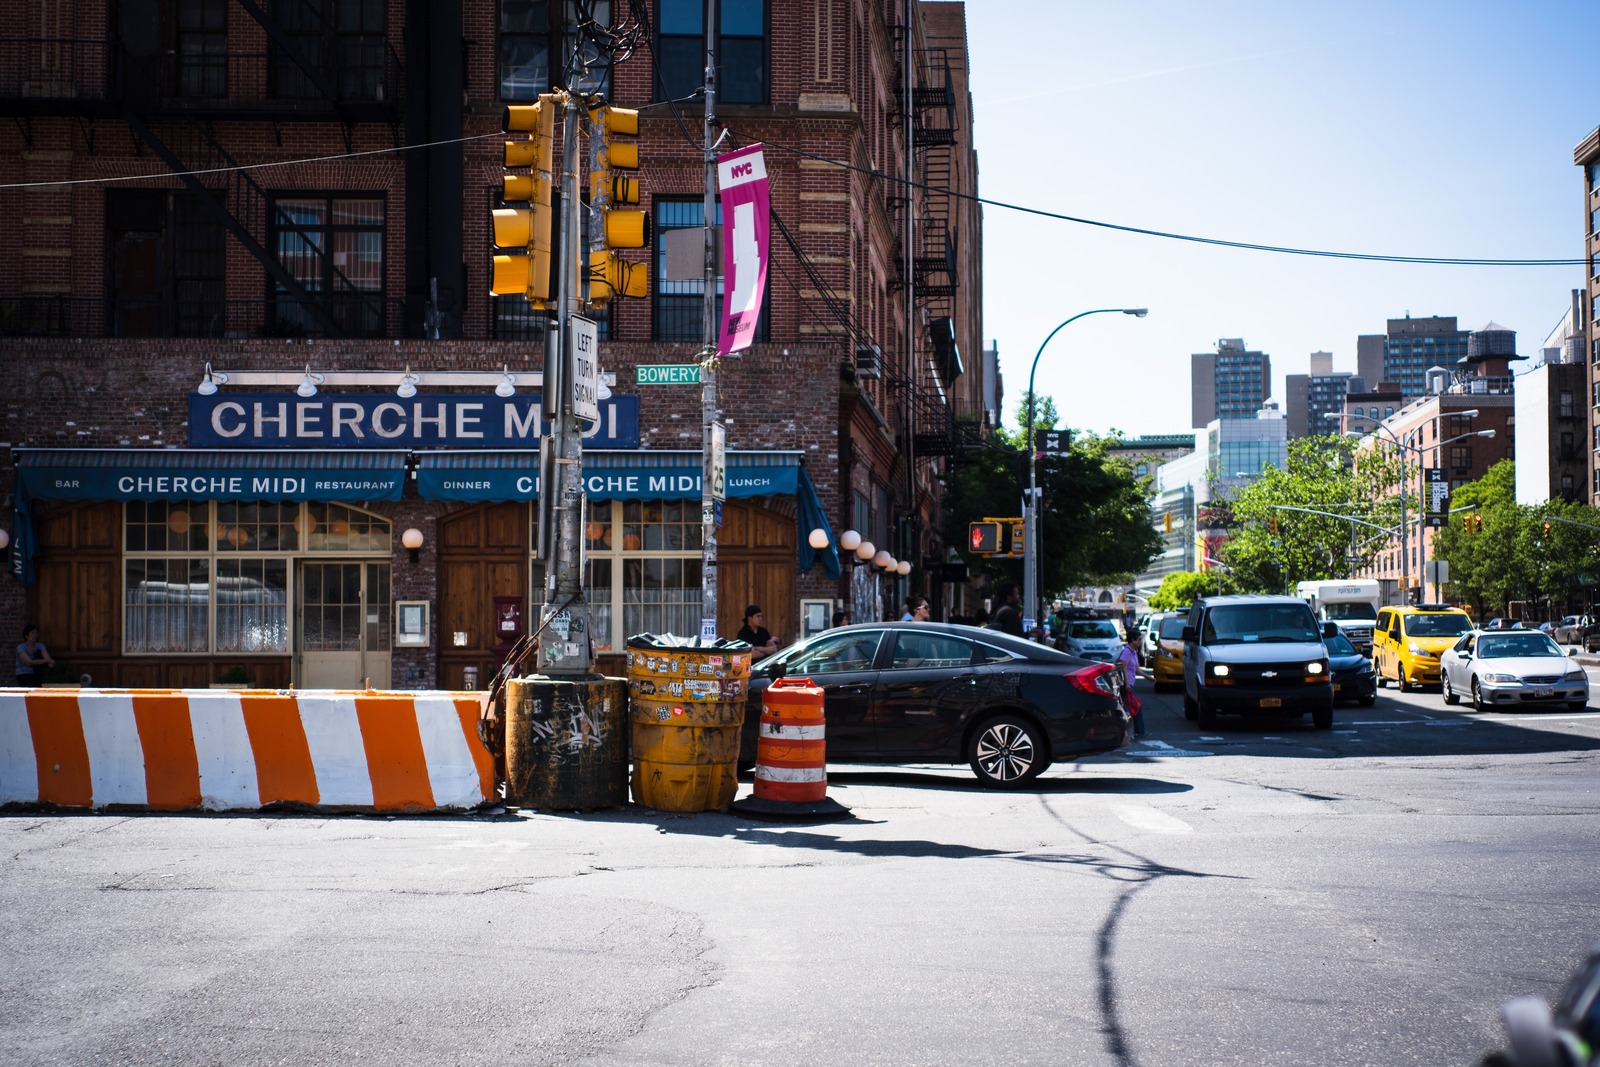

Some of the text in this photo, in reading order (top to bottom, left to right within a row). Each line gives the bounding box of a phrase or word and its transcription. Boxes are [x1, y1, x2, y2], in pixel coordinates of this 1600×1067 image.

[731, 162, 752, 179] NYC
[727, 321, 751, 336] MUSEUM
[728, 316, 742, 326] NEW
[577, 332, 592, 354] LEFT
[577, 358, 593, 379] TURN
[637, 367, 699, 382] BOWERY
[575, 383, 596, 405] SIGNAL
[211, 402, 484, 438] CHERCHE
[55, 476, 395, 494] BAR CHERCHE MIDI RESTAURANT
[443, 475, 770, 493] DINNER CCHE MIDI LUNCH
[713, 465, 724, 494] 25
